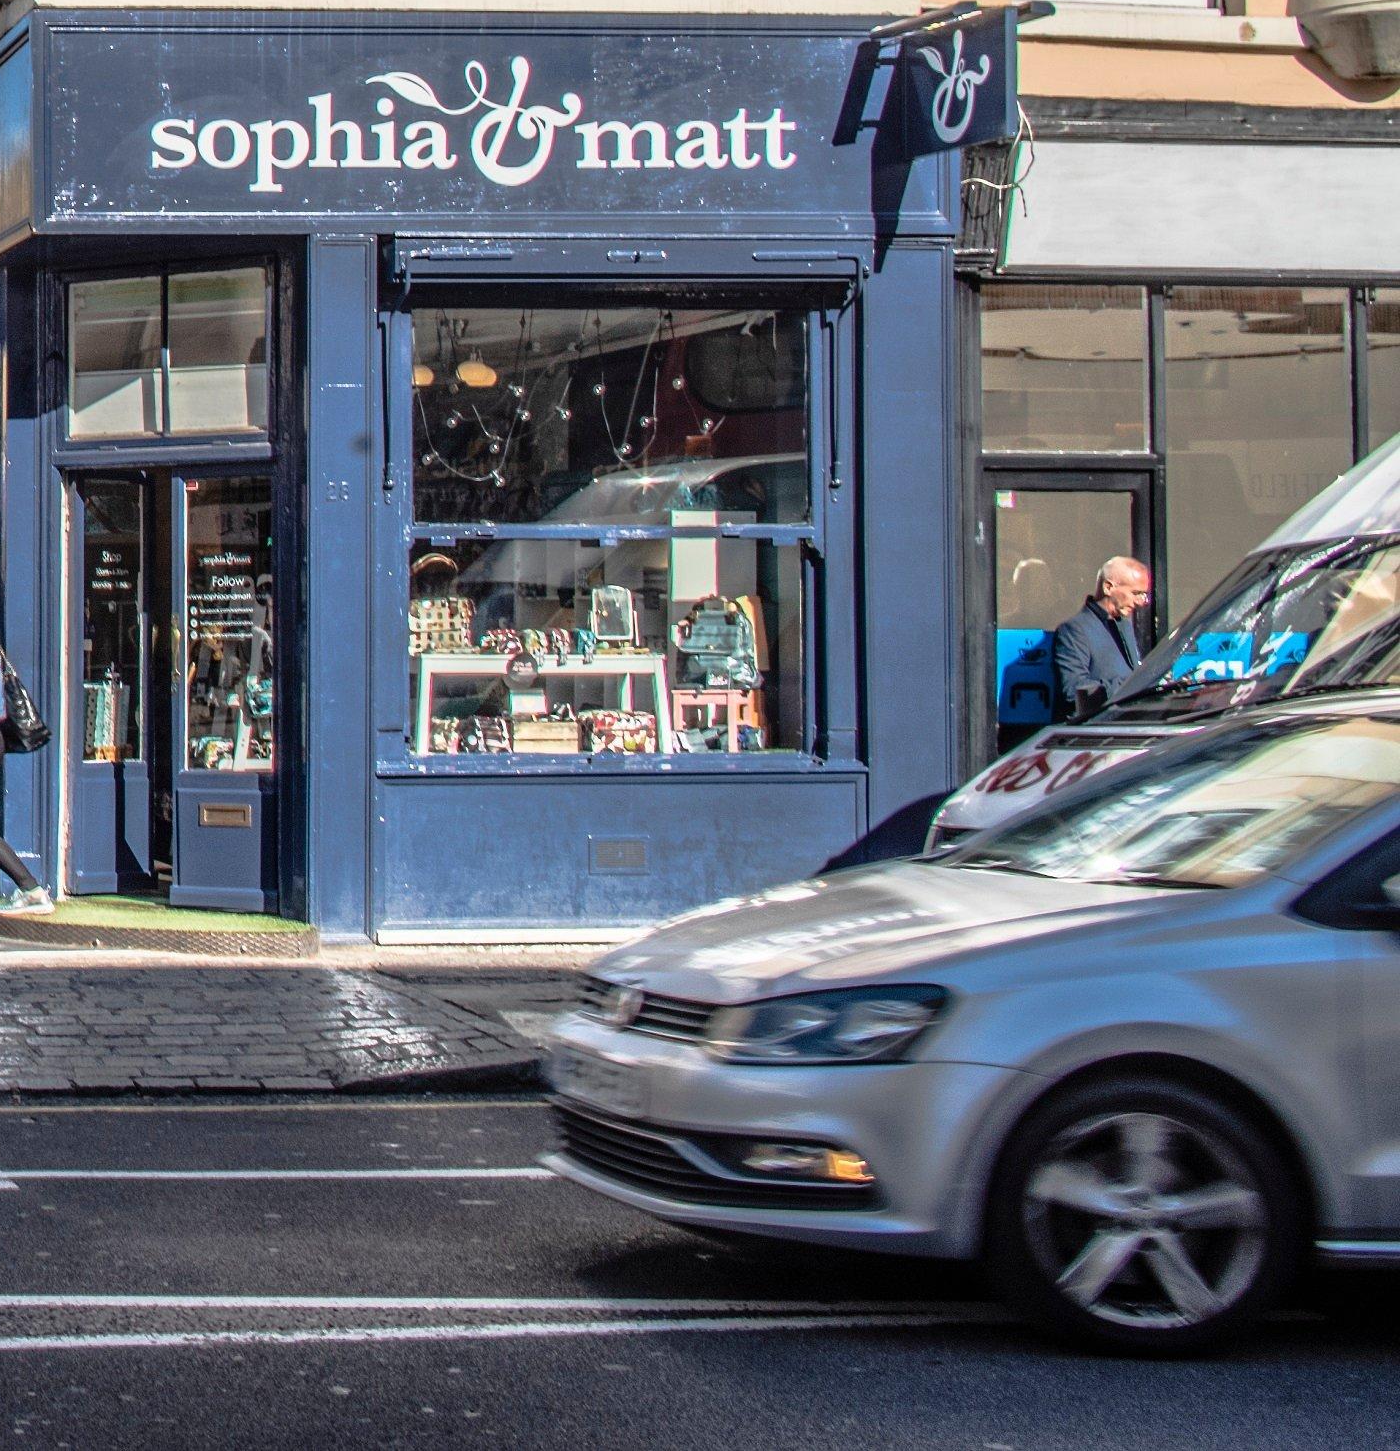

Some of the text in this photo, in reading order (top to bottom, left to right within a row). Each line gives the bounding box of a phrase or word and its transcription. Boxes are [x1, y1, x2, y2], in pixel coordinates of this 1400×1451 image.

[150, 91, 458, 193] sophia
[574, 108, 796, 169] matt
[212, 575, 245, 587] Follow
